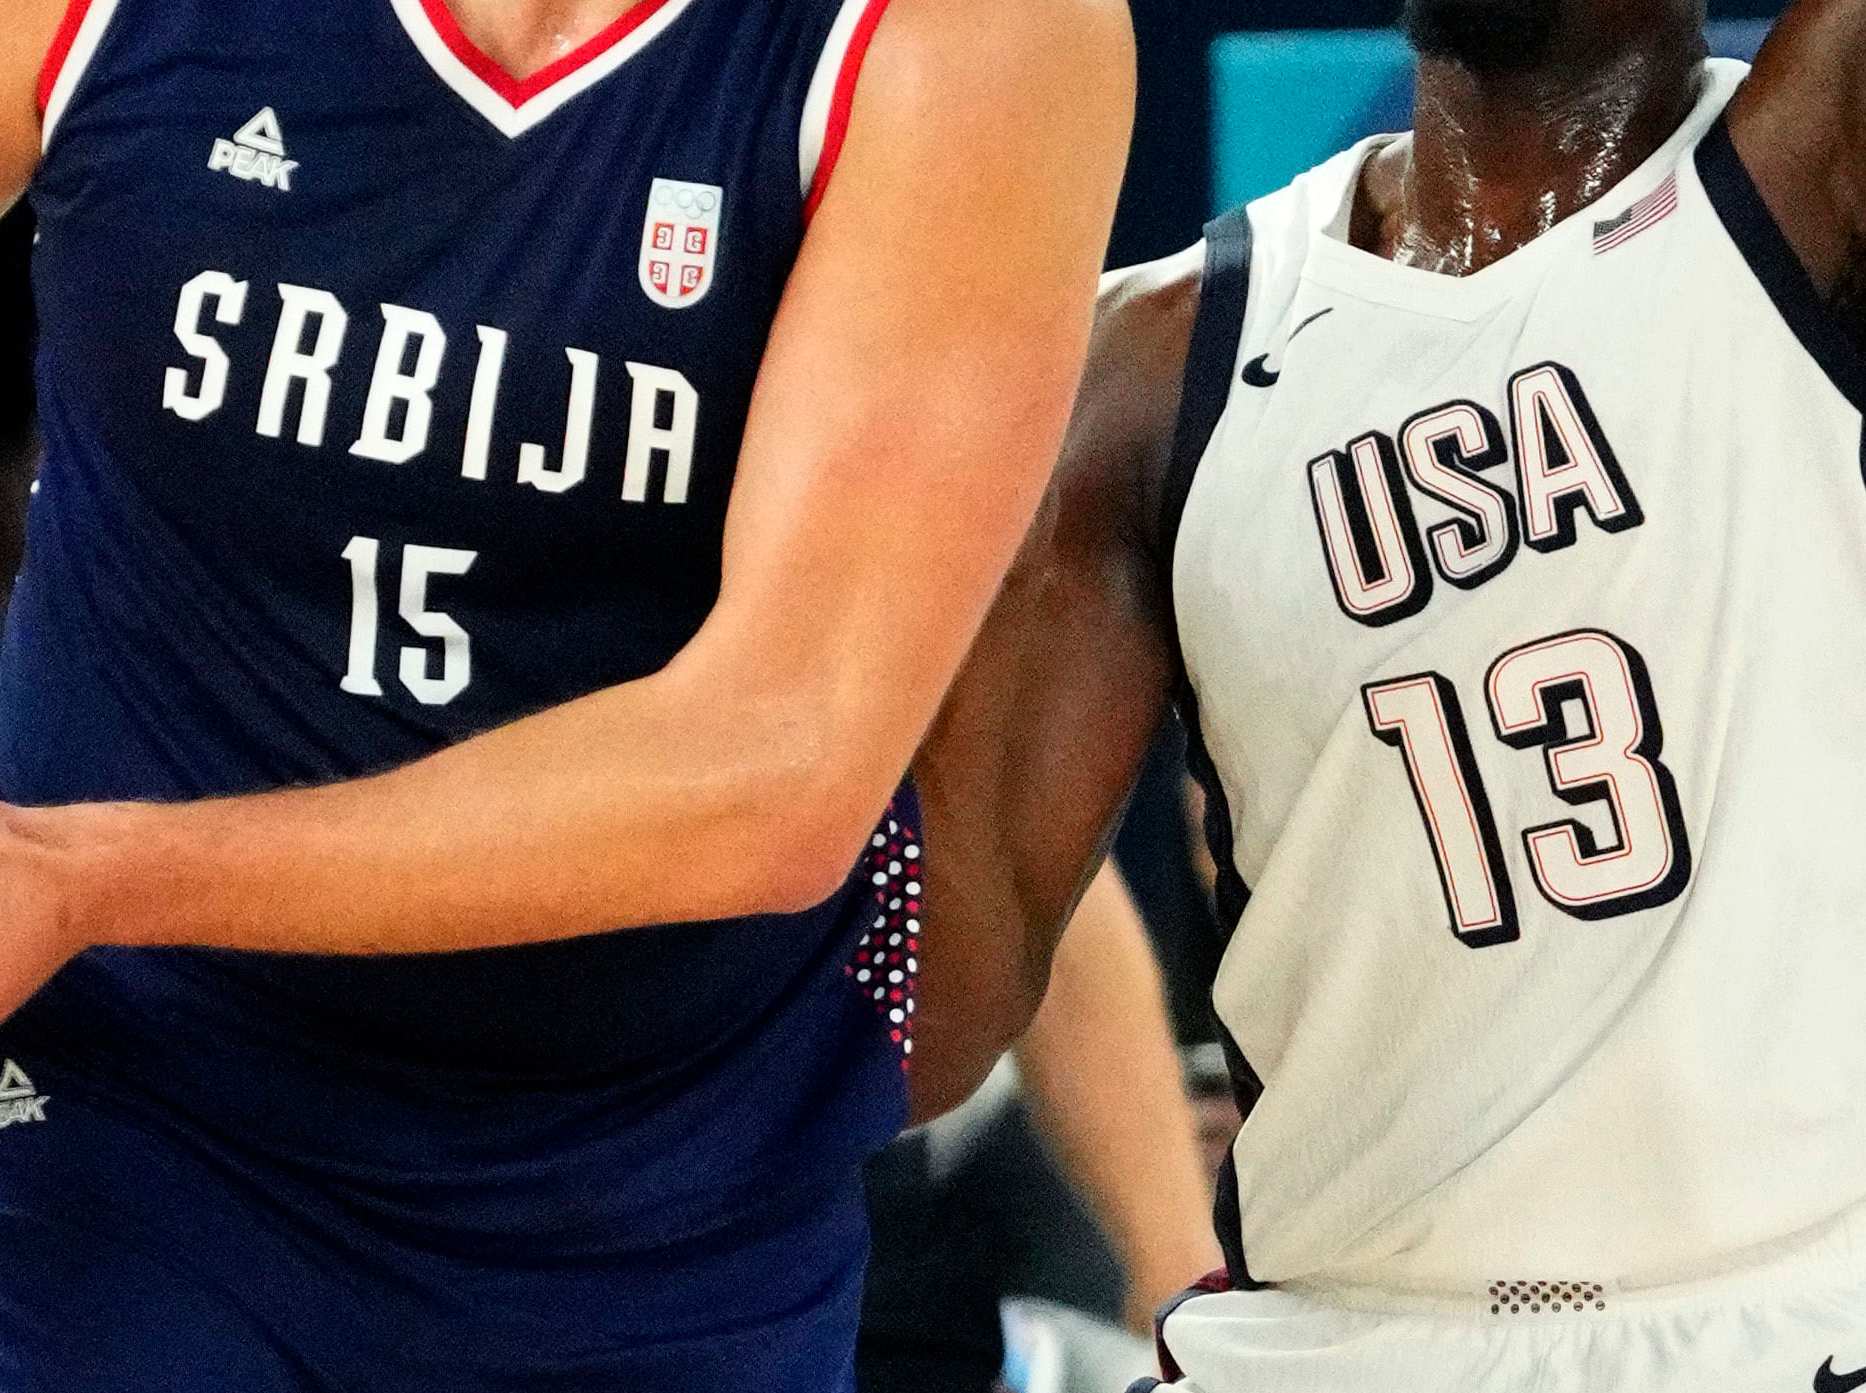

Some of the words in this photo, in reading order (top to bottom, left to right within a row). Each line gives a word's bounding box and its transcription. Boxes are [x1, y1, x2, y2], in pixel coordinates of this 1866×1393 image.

[207, 137, 300, 192] PEAK
[162, 269, 700, 504] SRBIJA
[1305, 360, 1645, 629] USA
[339, 535, 478, 705] 15
[1361, 627, 1693, 950] 13
